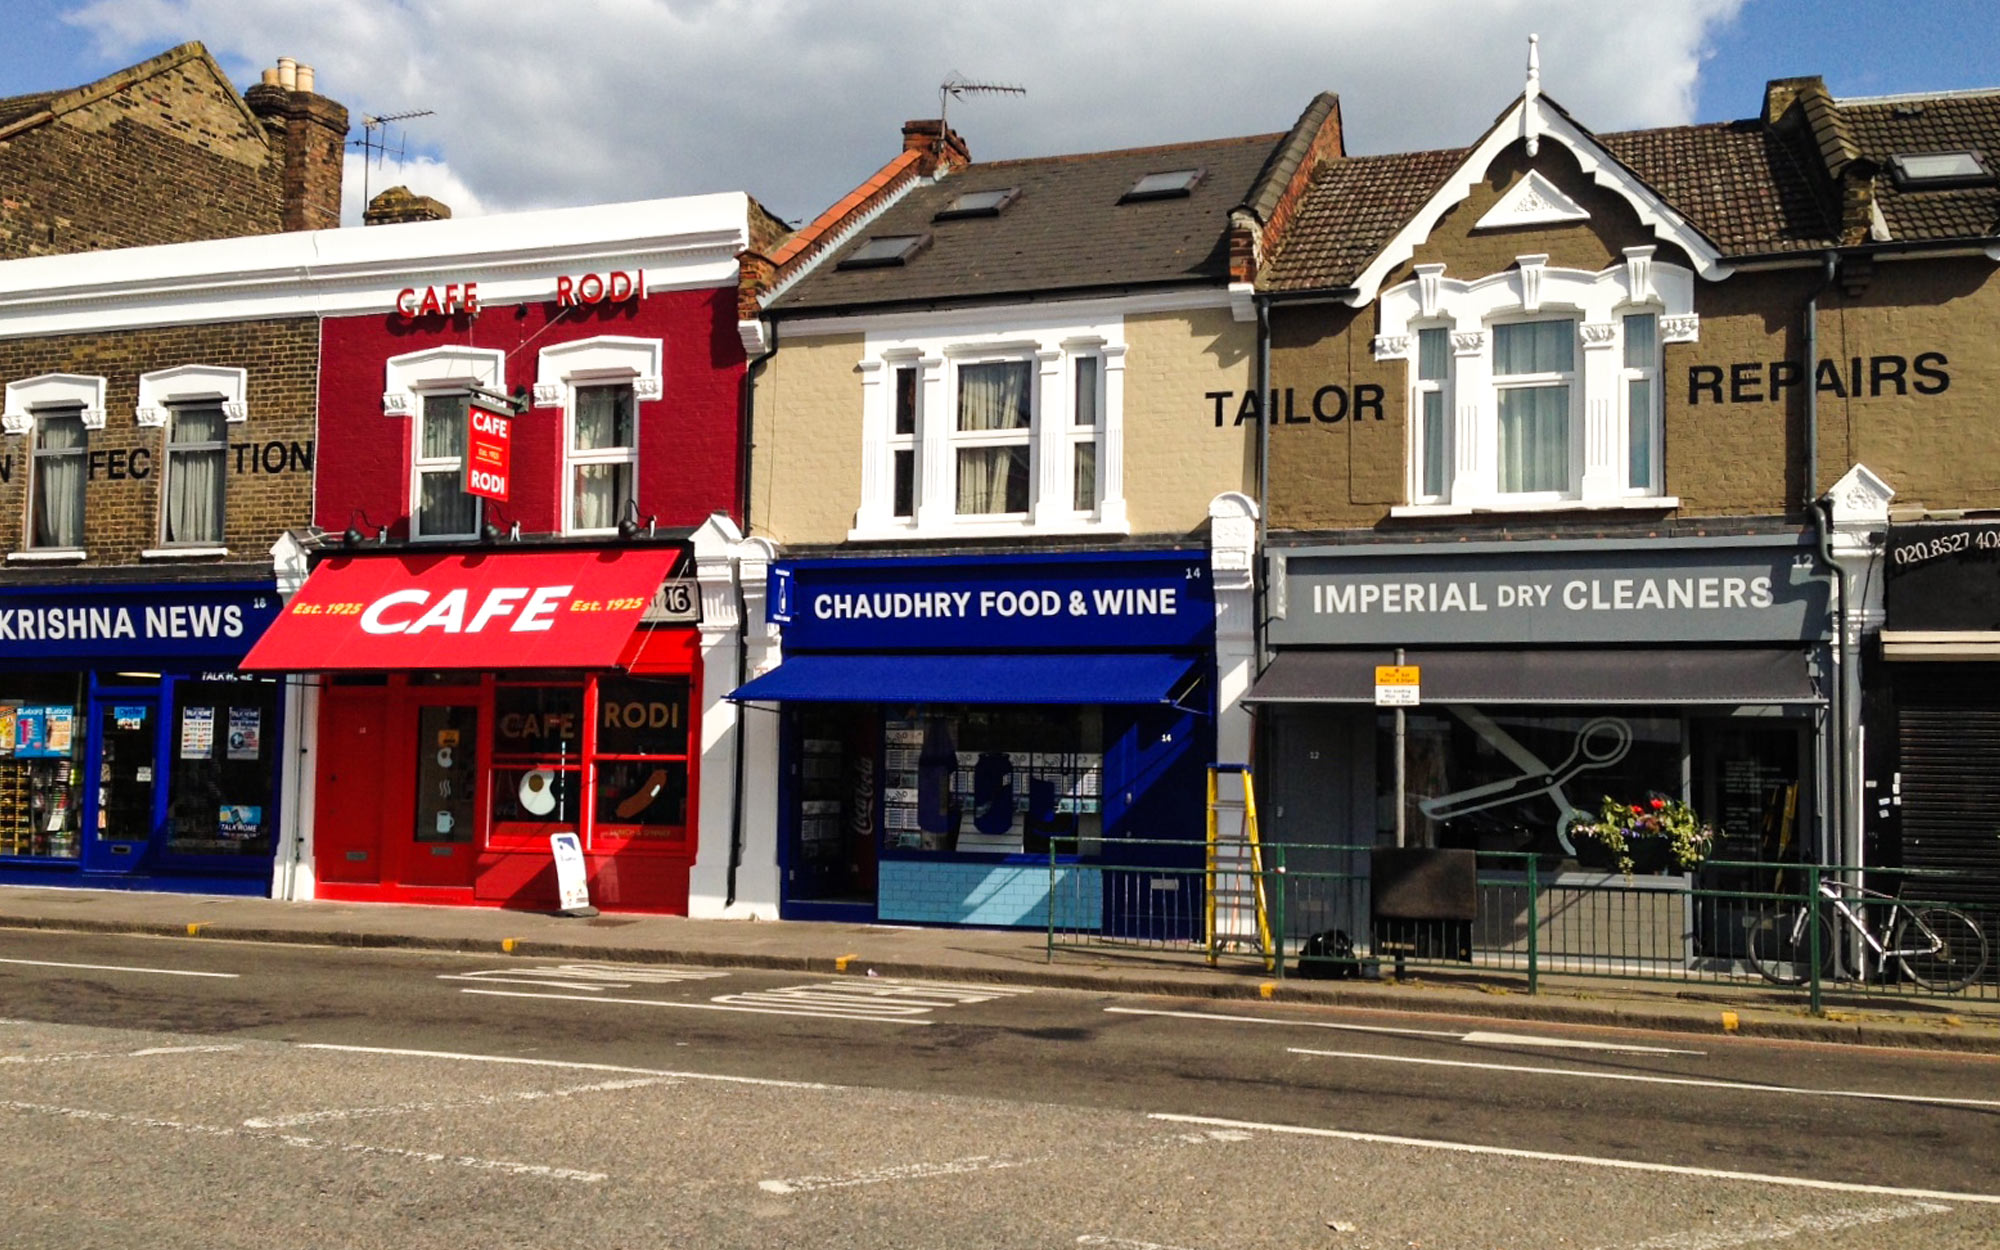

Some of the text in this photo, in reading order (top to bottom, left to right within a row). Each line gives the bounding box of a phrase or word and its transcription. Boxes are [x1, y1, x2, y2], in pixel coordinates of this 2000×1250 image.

[396, 268, 648, 319] CAFE RODI
[1688, 352, 1950, 404] REPAIRS
[1205, 383, 1385, 427] TAILOR
[473, 412, 507, 438] CAFE
[89, 447, 151, 480] FEC
[231, 440, 313, 474] TION
[471, 470, 505, 494] RODI
[1186, 568, 1200, 580] 14
[1792, 555, 1814, 568] 12
[292, 602, 323, 615] Est.
[325, 602, 363, 616] 1925
[359, 585, 574, 635] CAFE
[570, 599, 603, 612] Est.
[606, 597, 643, 611] 1925
[667, 588, 687, 611] 16
[815, 588, 1177, 620] CHAUDHRY FOOD & WINE
[1313, 576, 1774, 613] IMPERIAL DRY CLEANERS
[0, 605, 243, 640] KRISHNA NEWS
[502, 713, 575, 739] CAFE
[604, 702, 679, 729] RODI
